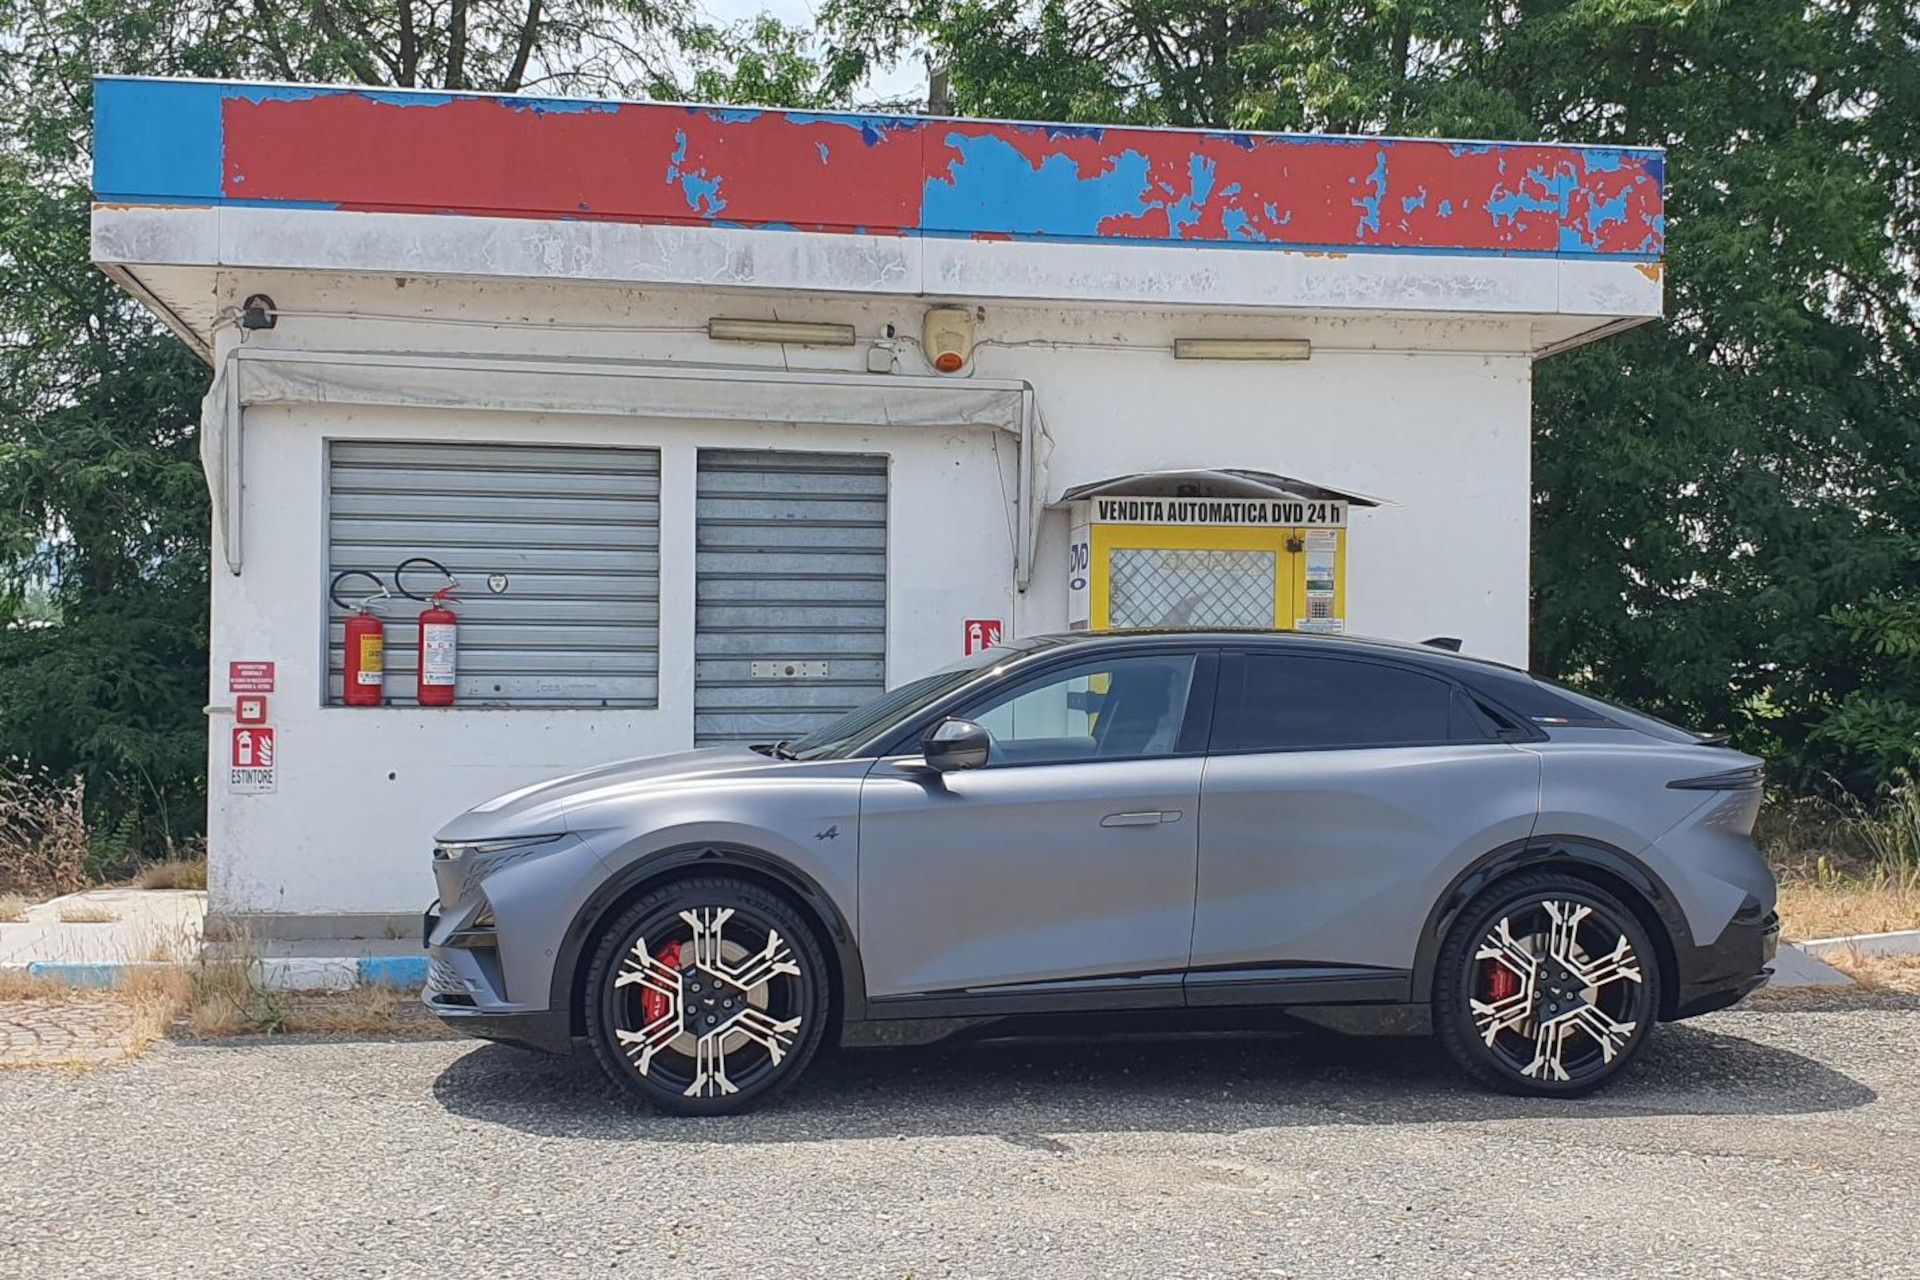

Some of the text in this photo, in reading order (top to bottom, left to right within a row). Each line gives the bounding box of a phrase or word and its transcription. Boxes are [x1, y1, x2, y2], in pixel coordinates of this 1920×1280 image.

[1099, 500, 1340, 523] VENDITA AUTOMATICA DVD 24 h
[231, 769, 273, 784] ESTINTORE
